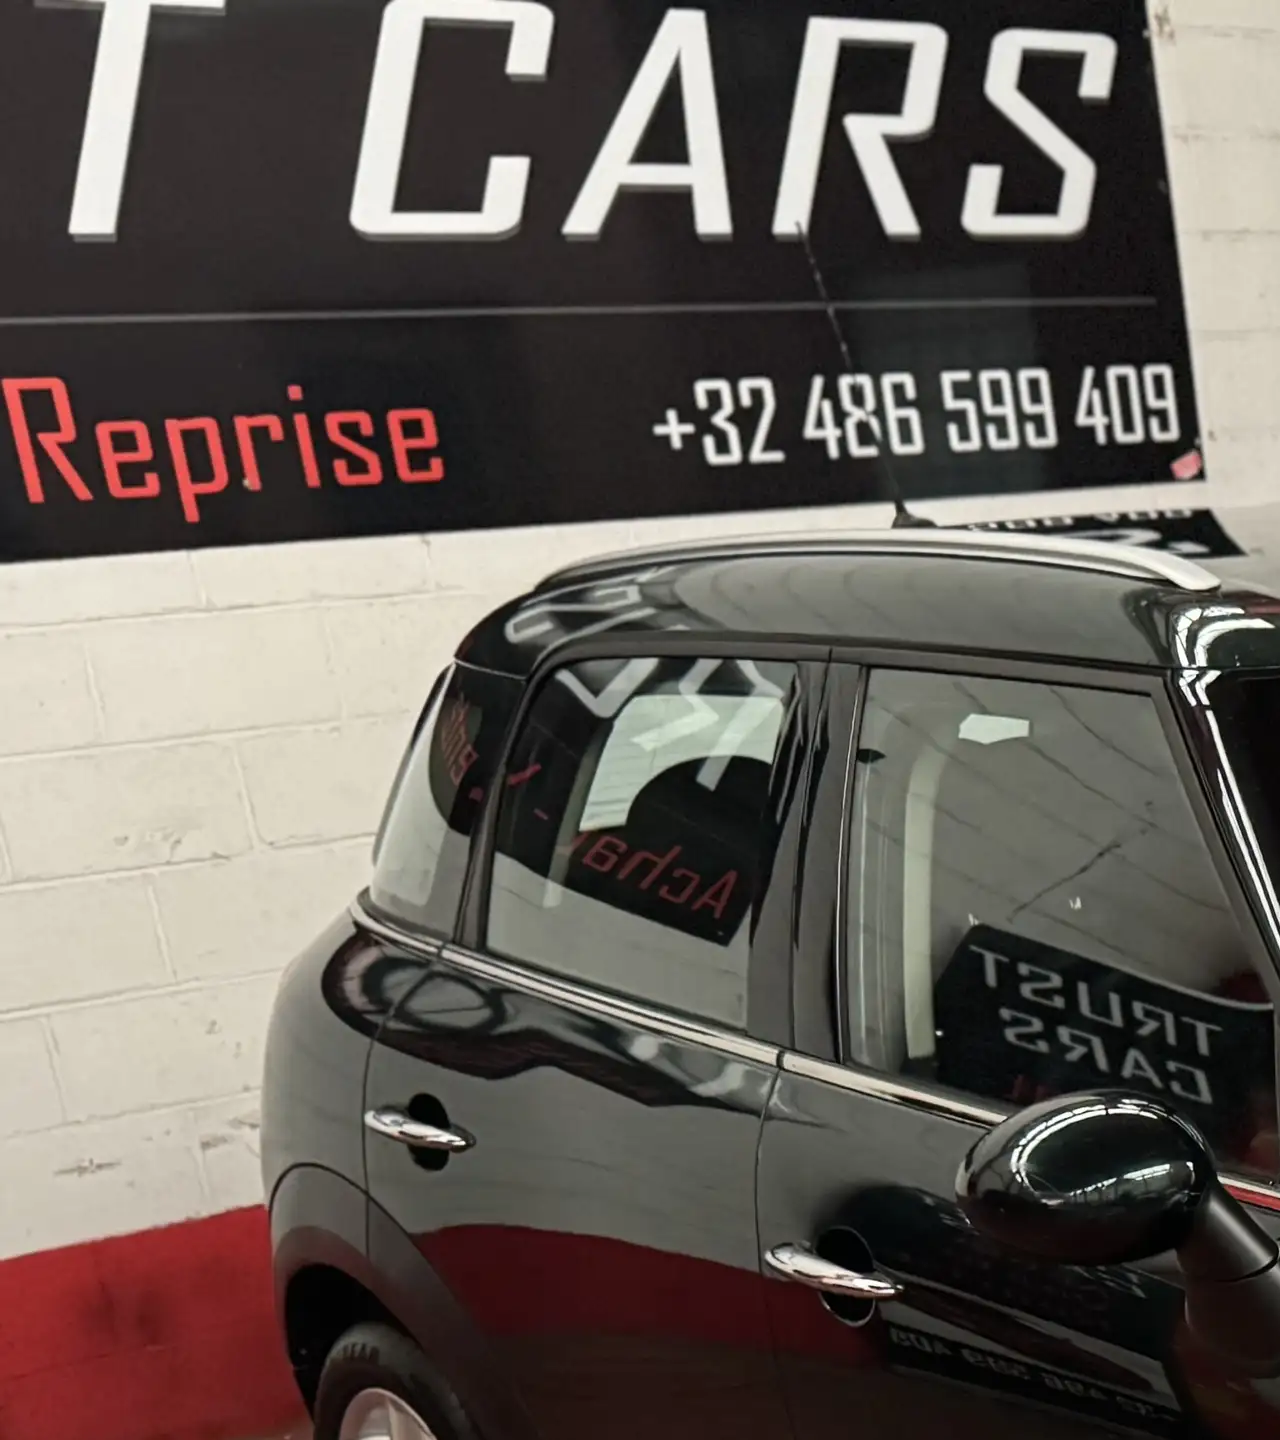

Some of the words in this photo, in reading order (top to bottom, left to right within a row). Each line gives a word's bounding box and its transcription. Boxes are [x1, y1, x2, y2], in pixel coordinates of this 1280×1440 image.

[34, 0, 226, 240] T
[349, 0, 1118, 240] CARS
[1, 376, 445, 523] Reprise
[653, 377, 785, 466] +32
[803, 372, 925, 460] 486
[939, 367, 1058, 453] 599
[1075, 364, 1180, 445] 409
